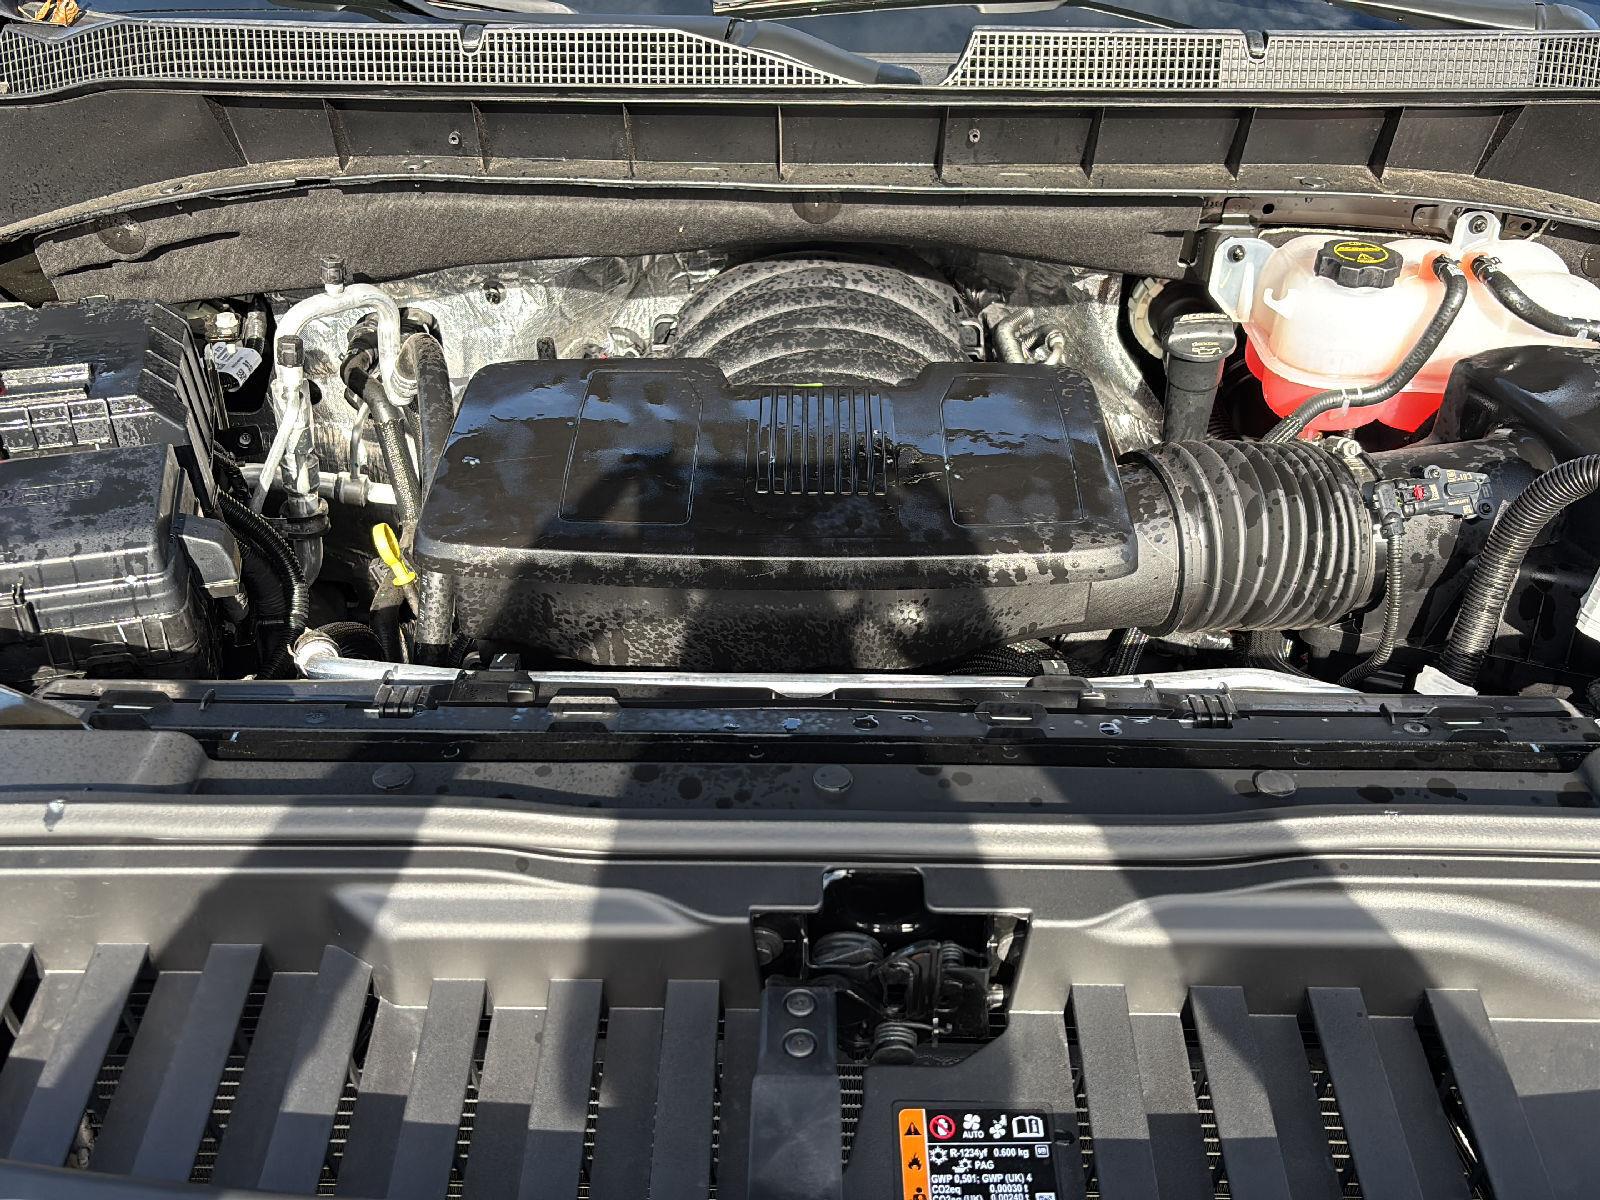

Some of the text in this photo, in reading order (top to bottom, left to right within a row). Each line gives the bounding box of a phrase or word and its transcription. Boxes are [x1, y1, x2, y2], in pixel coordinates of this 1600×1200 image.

[1180, 313, 1227, 322] ACDelco
[962, 1131, 985, 1139] AUTO
[949, 1147, 988, 1159] R-1234yf
[993, 1147, 1016, 1157] 0.600
[1017, 1147, 1030, 1159] kg
[974, 1160, 995, 1170] PAG
[931, 1172, 1033, 1184] GWP 0,501; GWP (UK) 4
[932, 1183, 1029, 1195] CO2eq 0,00030 t
